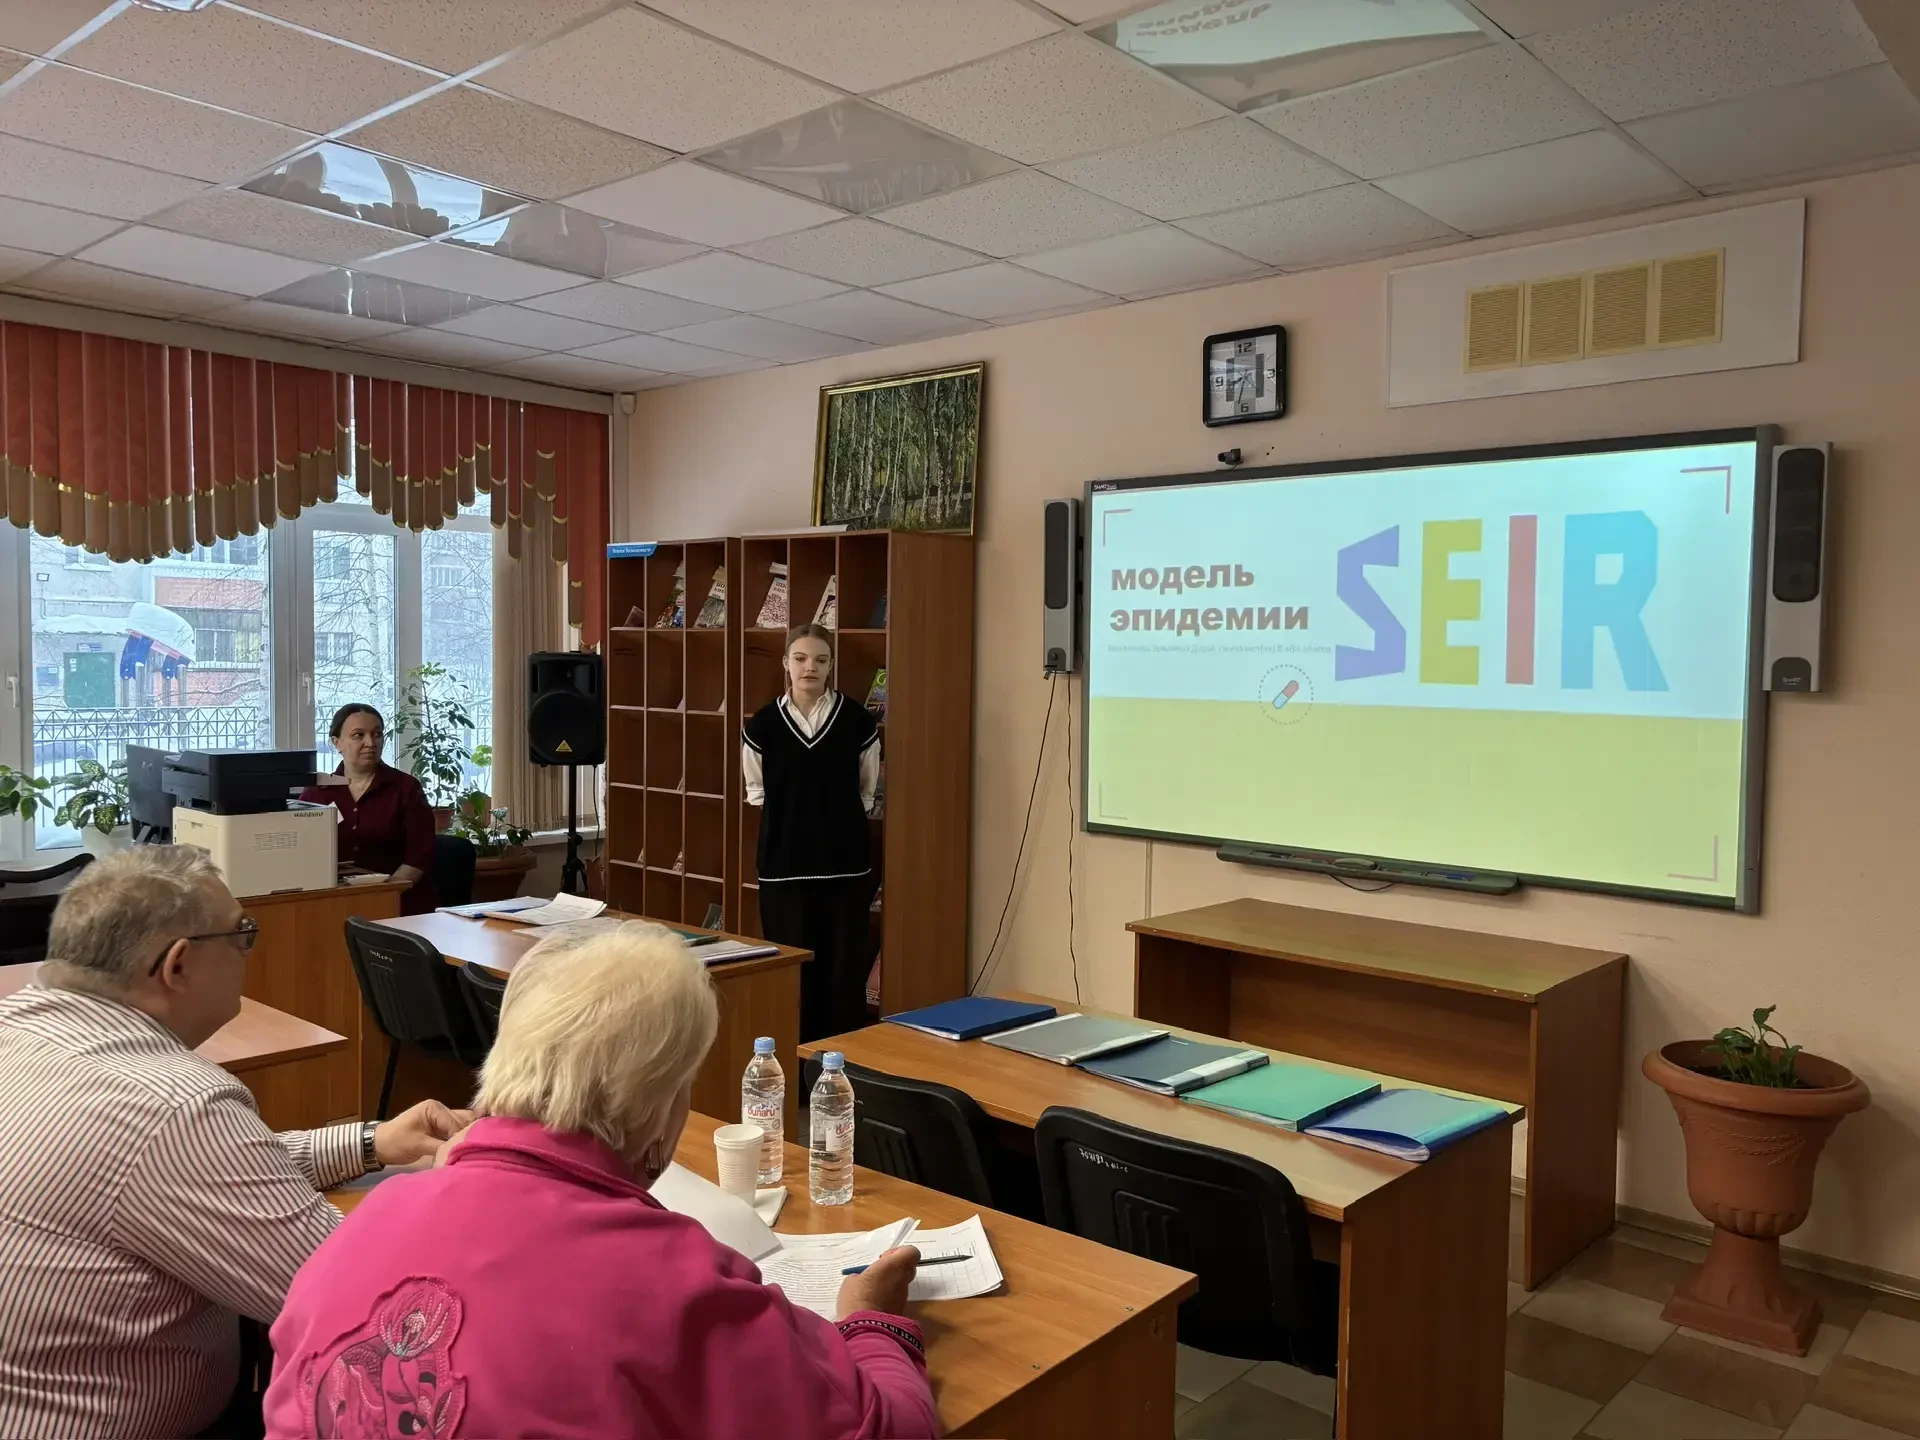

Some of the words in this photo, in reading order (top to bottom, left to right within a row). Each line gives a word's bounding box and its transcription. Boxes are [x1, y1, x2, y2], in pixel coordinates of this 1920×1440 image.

[1236, 342, 1253, 353] 12
[1266, 369, 1276, 379] 3
[1215, 376, 1224, 387] 9
[1240, 402, 1249, 413] 6
[1111, 564, 1255, 595] модель
[1335, 510, 1669, 692] SEIR
[1109, 606, 1309, 637] эпидемии
